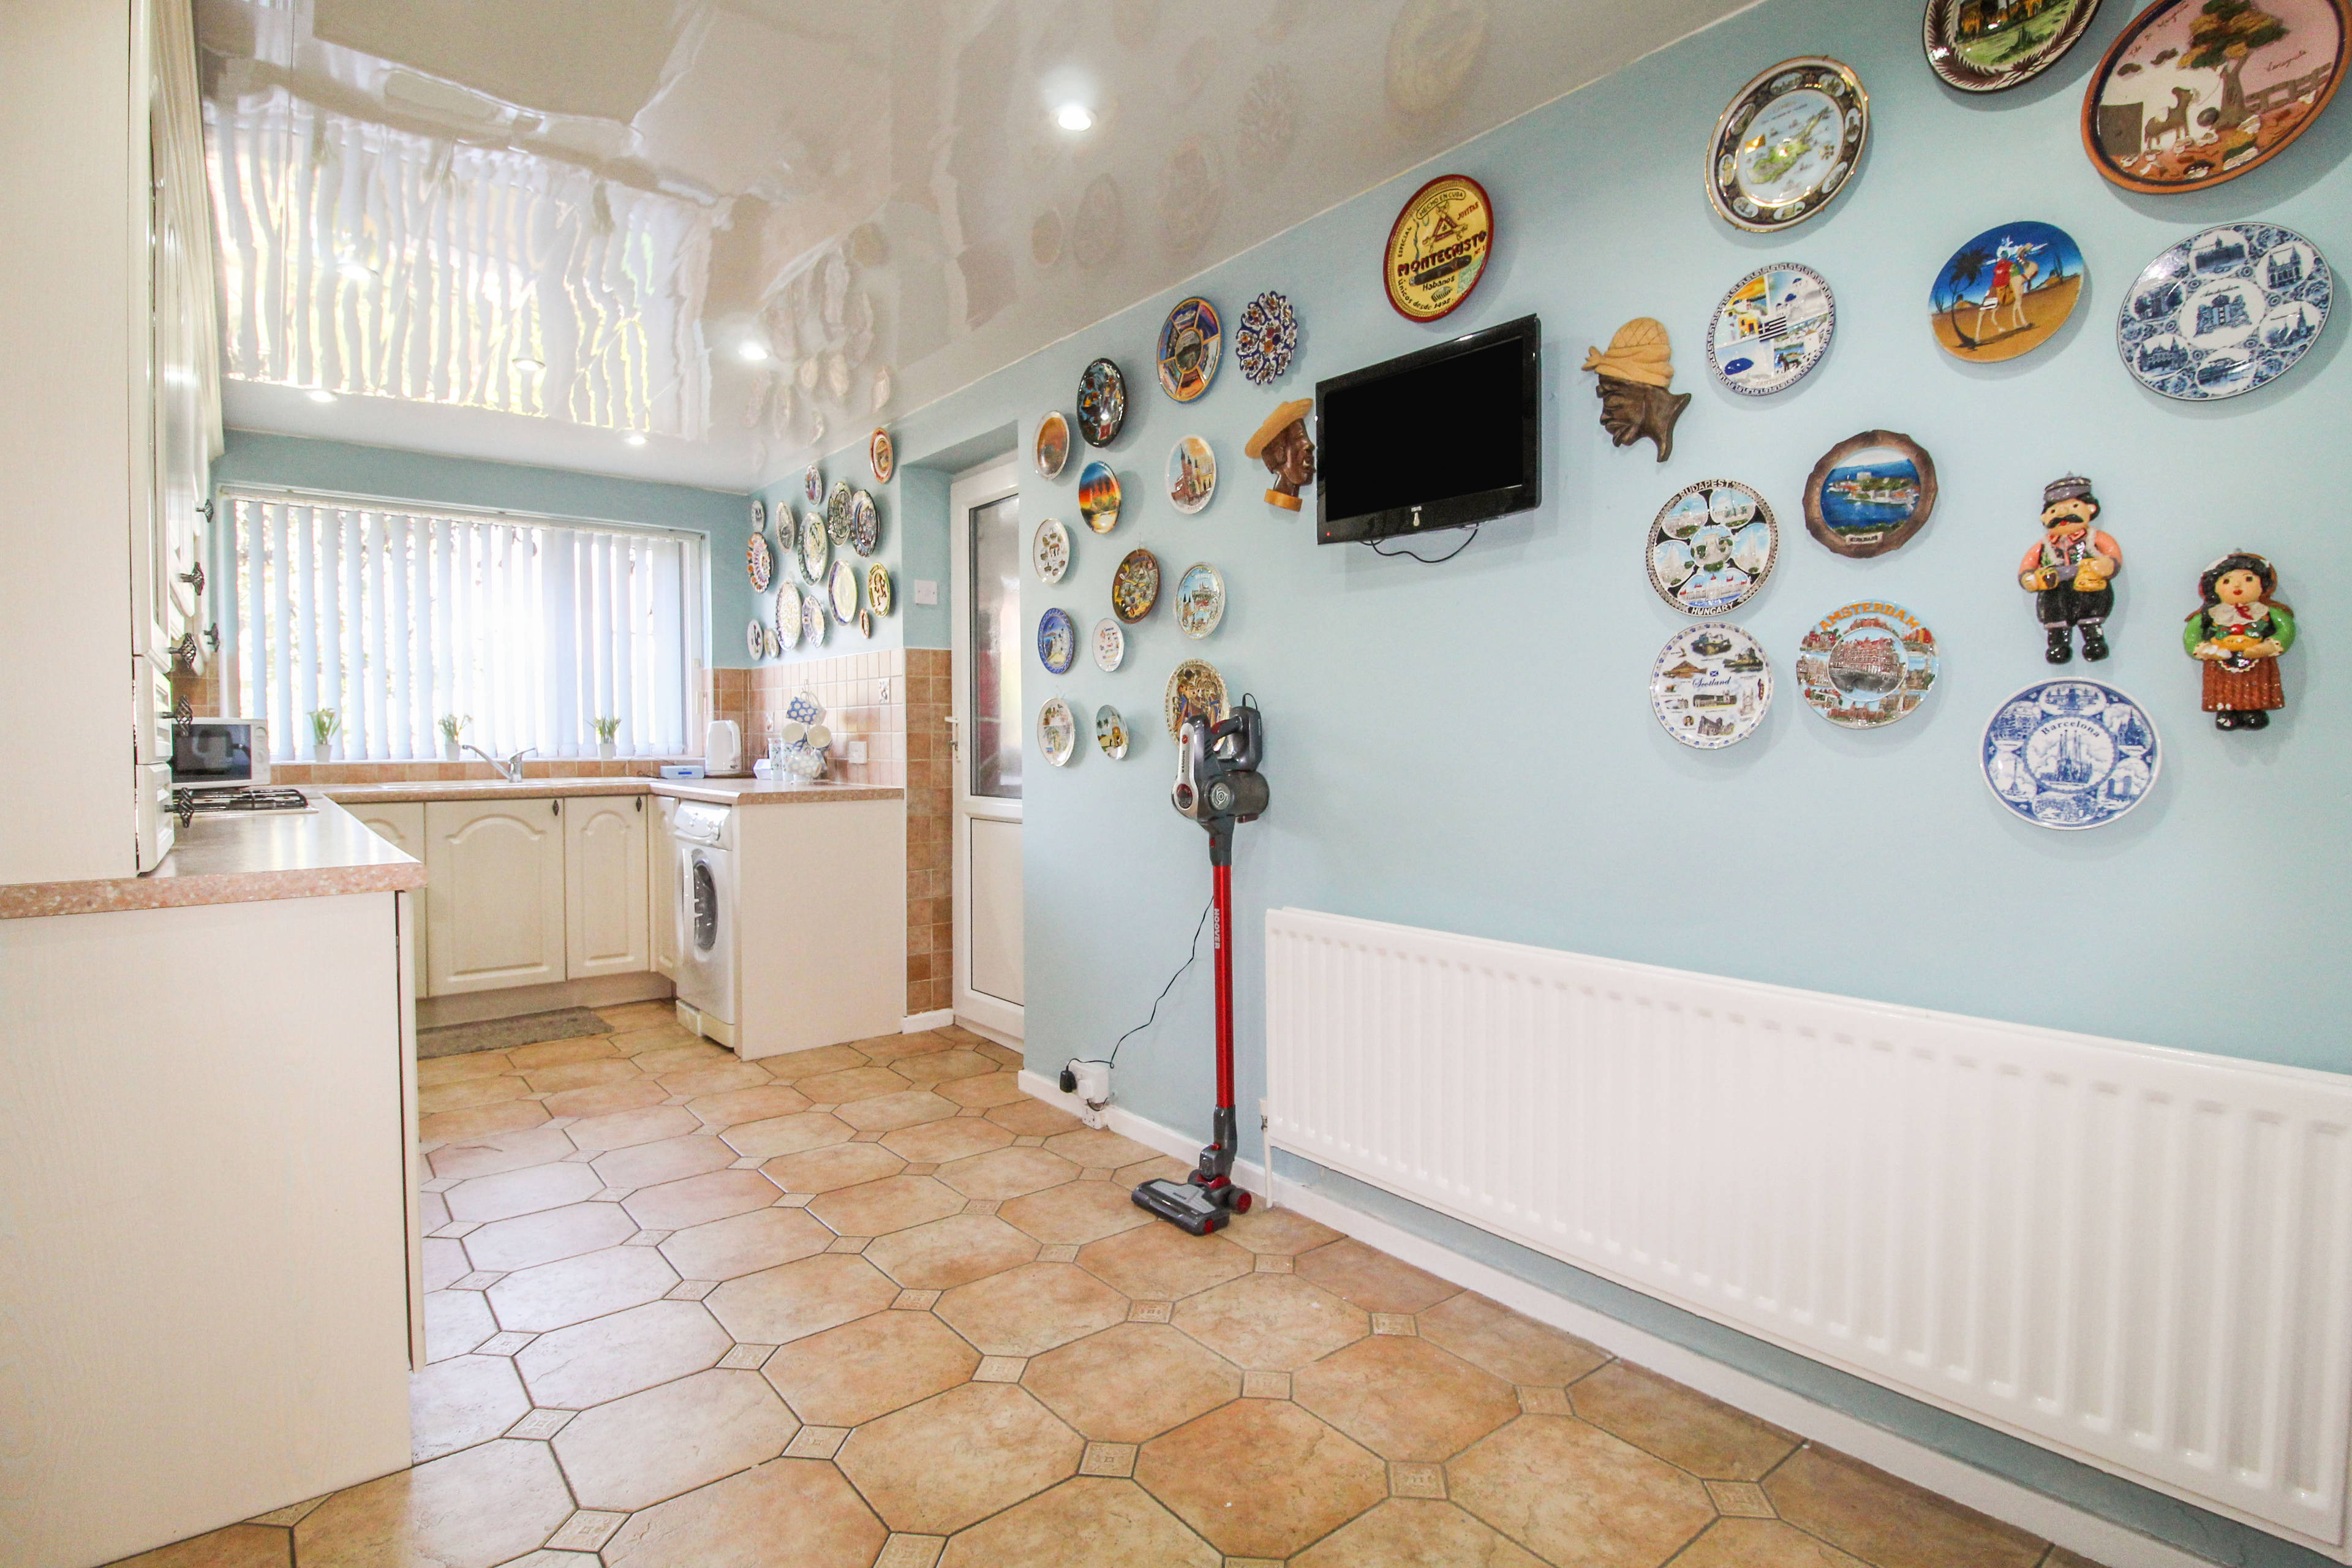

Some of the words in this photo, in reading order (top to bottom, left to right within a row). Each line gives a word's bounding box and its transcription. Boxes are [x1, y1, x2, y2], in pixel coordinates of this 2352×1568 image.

[1398, 227, 1412, 258] ESPECIAL
[1397, 230, 1487, 277] MONTECRISTO
[1422, 276, 1455, 292] Habanos
[1679, 479, 1733, 500] BUDAPEST
[1691, 601, 1734, 616] HUNGARY
[1819, 602, 1921, 631] AMSTERDAM
[1692, 676, 1732, 688] Scotland
[2041, 720, 2100, 737] Barcelona
